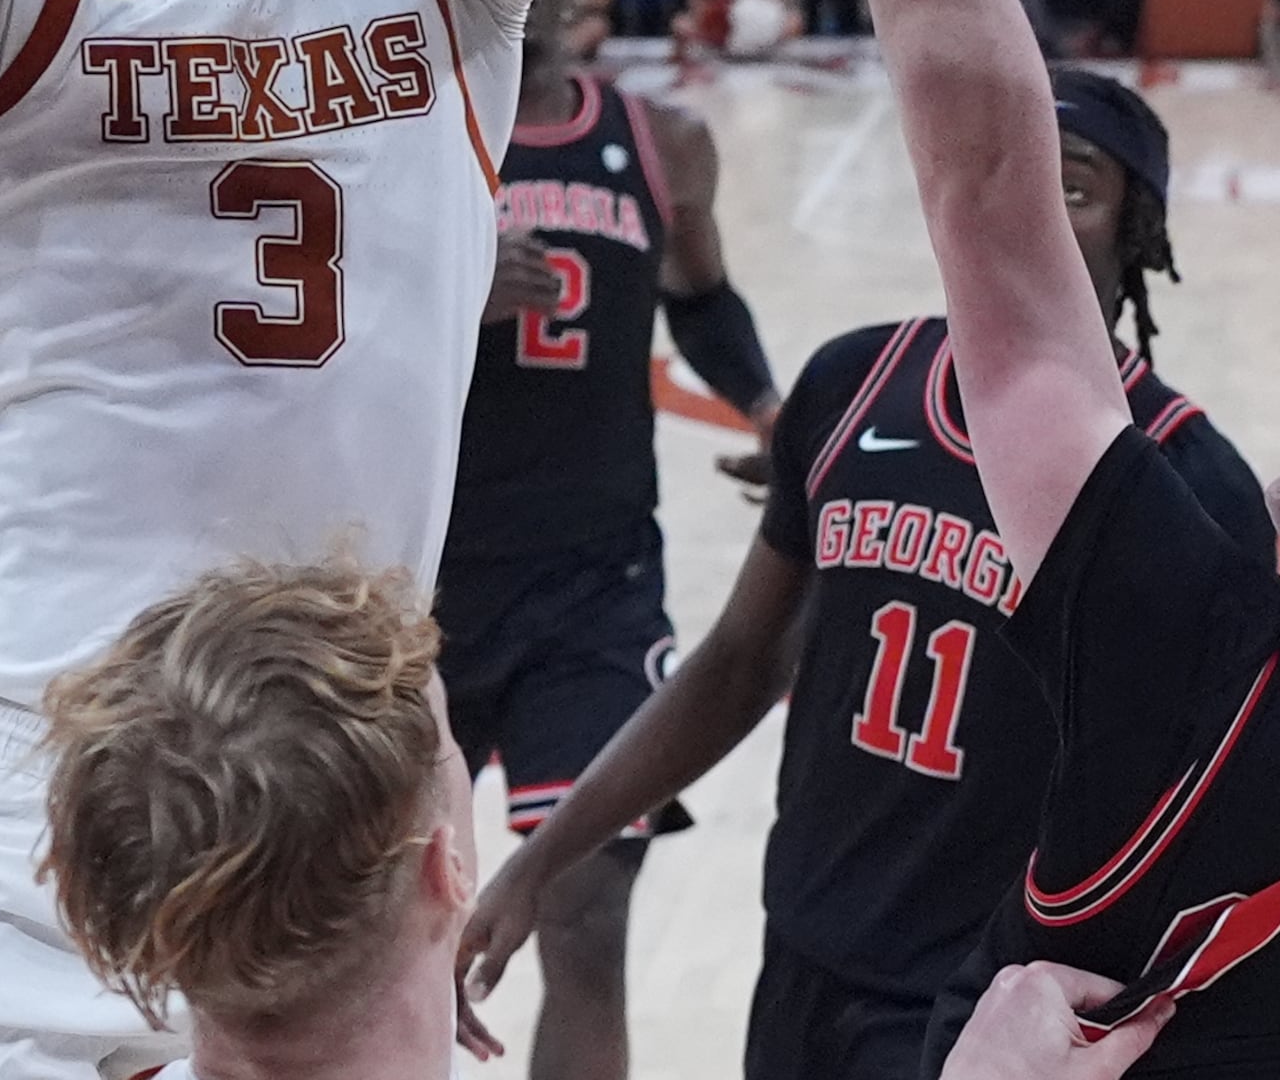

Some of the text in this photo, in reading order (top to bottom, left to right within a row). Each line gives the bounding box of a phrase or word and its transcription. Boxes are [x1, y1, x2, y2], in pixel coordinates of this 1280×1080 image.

[82, 13, 436, 143] TEXAS
[210, 158, 345, 368] 3
[851, 600, 978, 781] 11
